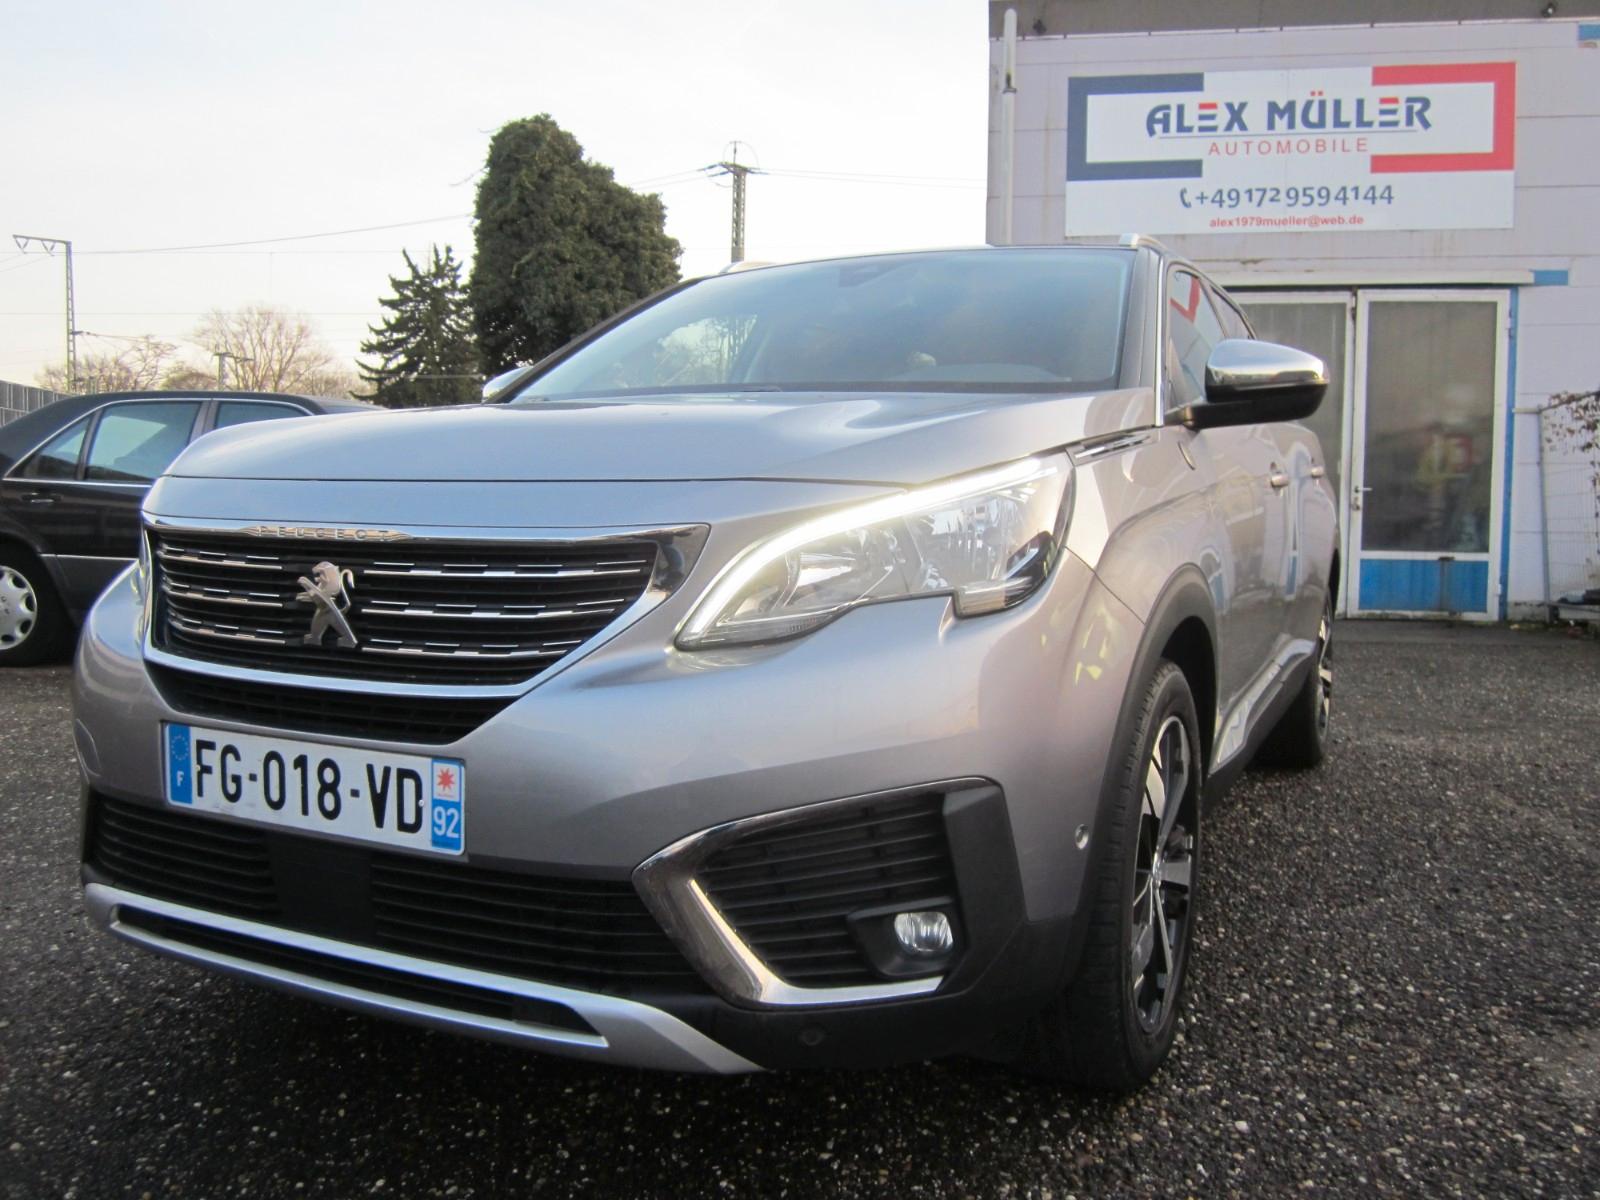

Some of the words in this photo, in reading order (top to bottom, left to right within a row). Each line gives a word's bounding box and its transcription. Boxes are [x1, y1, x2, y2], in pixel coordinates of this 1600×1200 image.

[1146, 102, 1248, 137] ALEX
[1266, 91, 1431, 131] MÜLLER
[1208, 137, 1369, 156] AUTOMOBILE
[1209, 214, 1364, 228] alex1979mueller@web.de
[258, 526, 389, 541] PEUGEOT
[177, 772, 184, 787] F
[196, 740, 423, 834] FG-018-VD
[433, 806, 460, 838] 92
